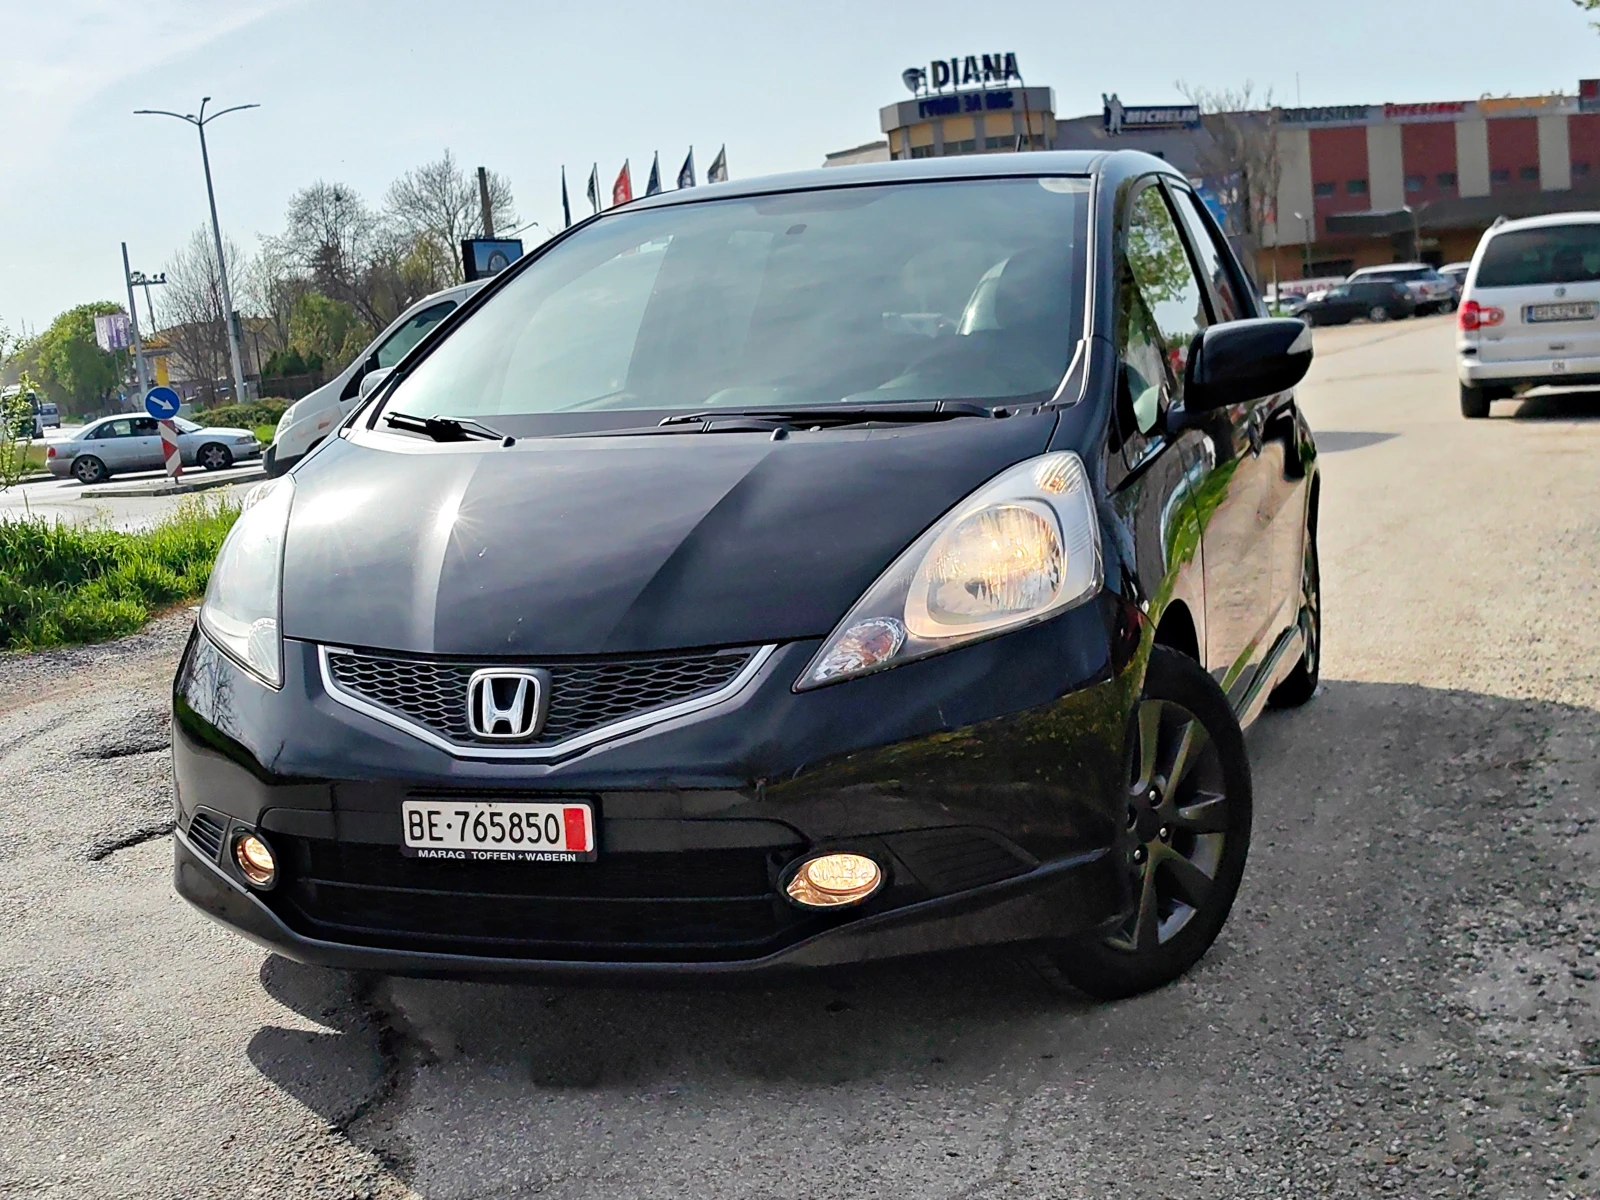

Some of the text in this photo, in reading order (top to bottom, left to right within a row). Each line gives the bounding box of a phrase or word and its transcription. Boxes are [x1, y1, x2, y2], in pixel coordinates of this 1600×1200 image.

[931, 52, 1020, 88] DIANA
[1126, 109, 1197, 123] MICHELIN
[418, 849, 466, 860] MARAG
[471, 851, 516, 861] TOFFEN
[525, 853, 576, 862] WABERN
